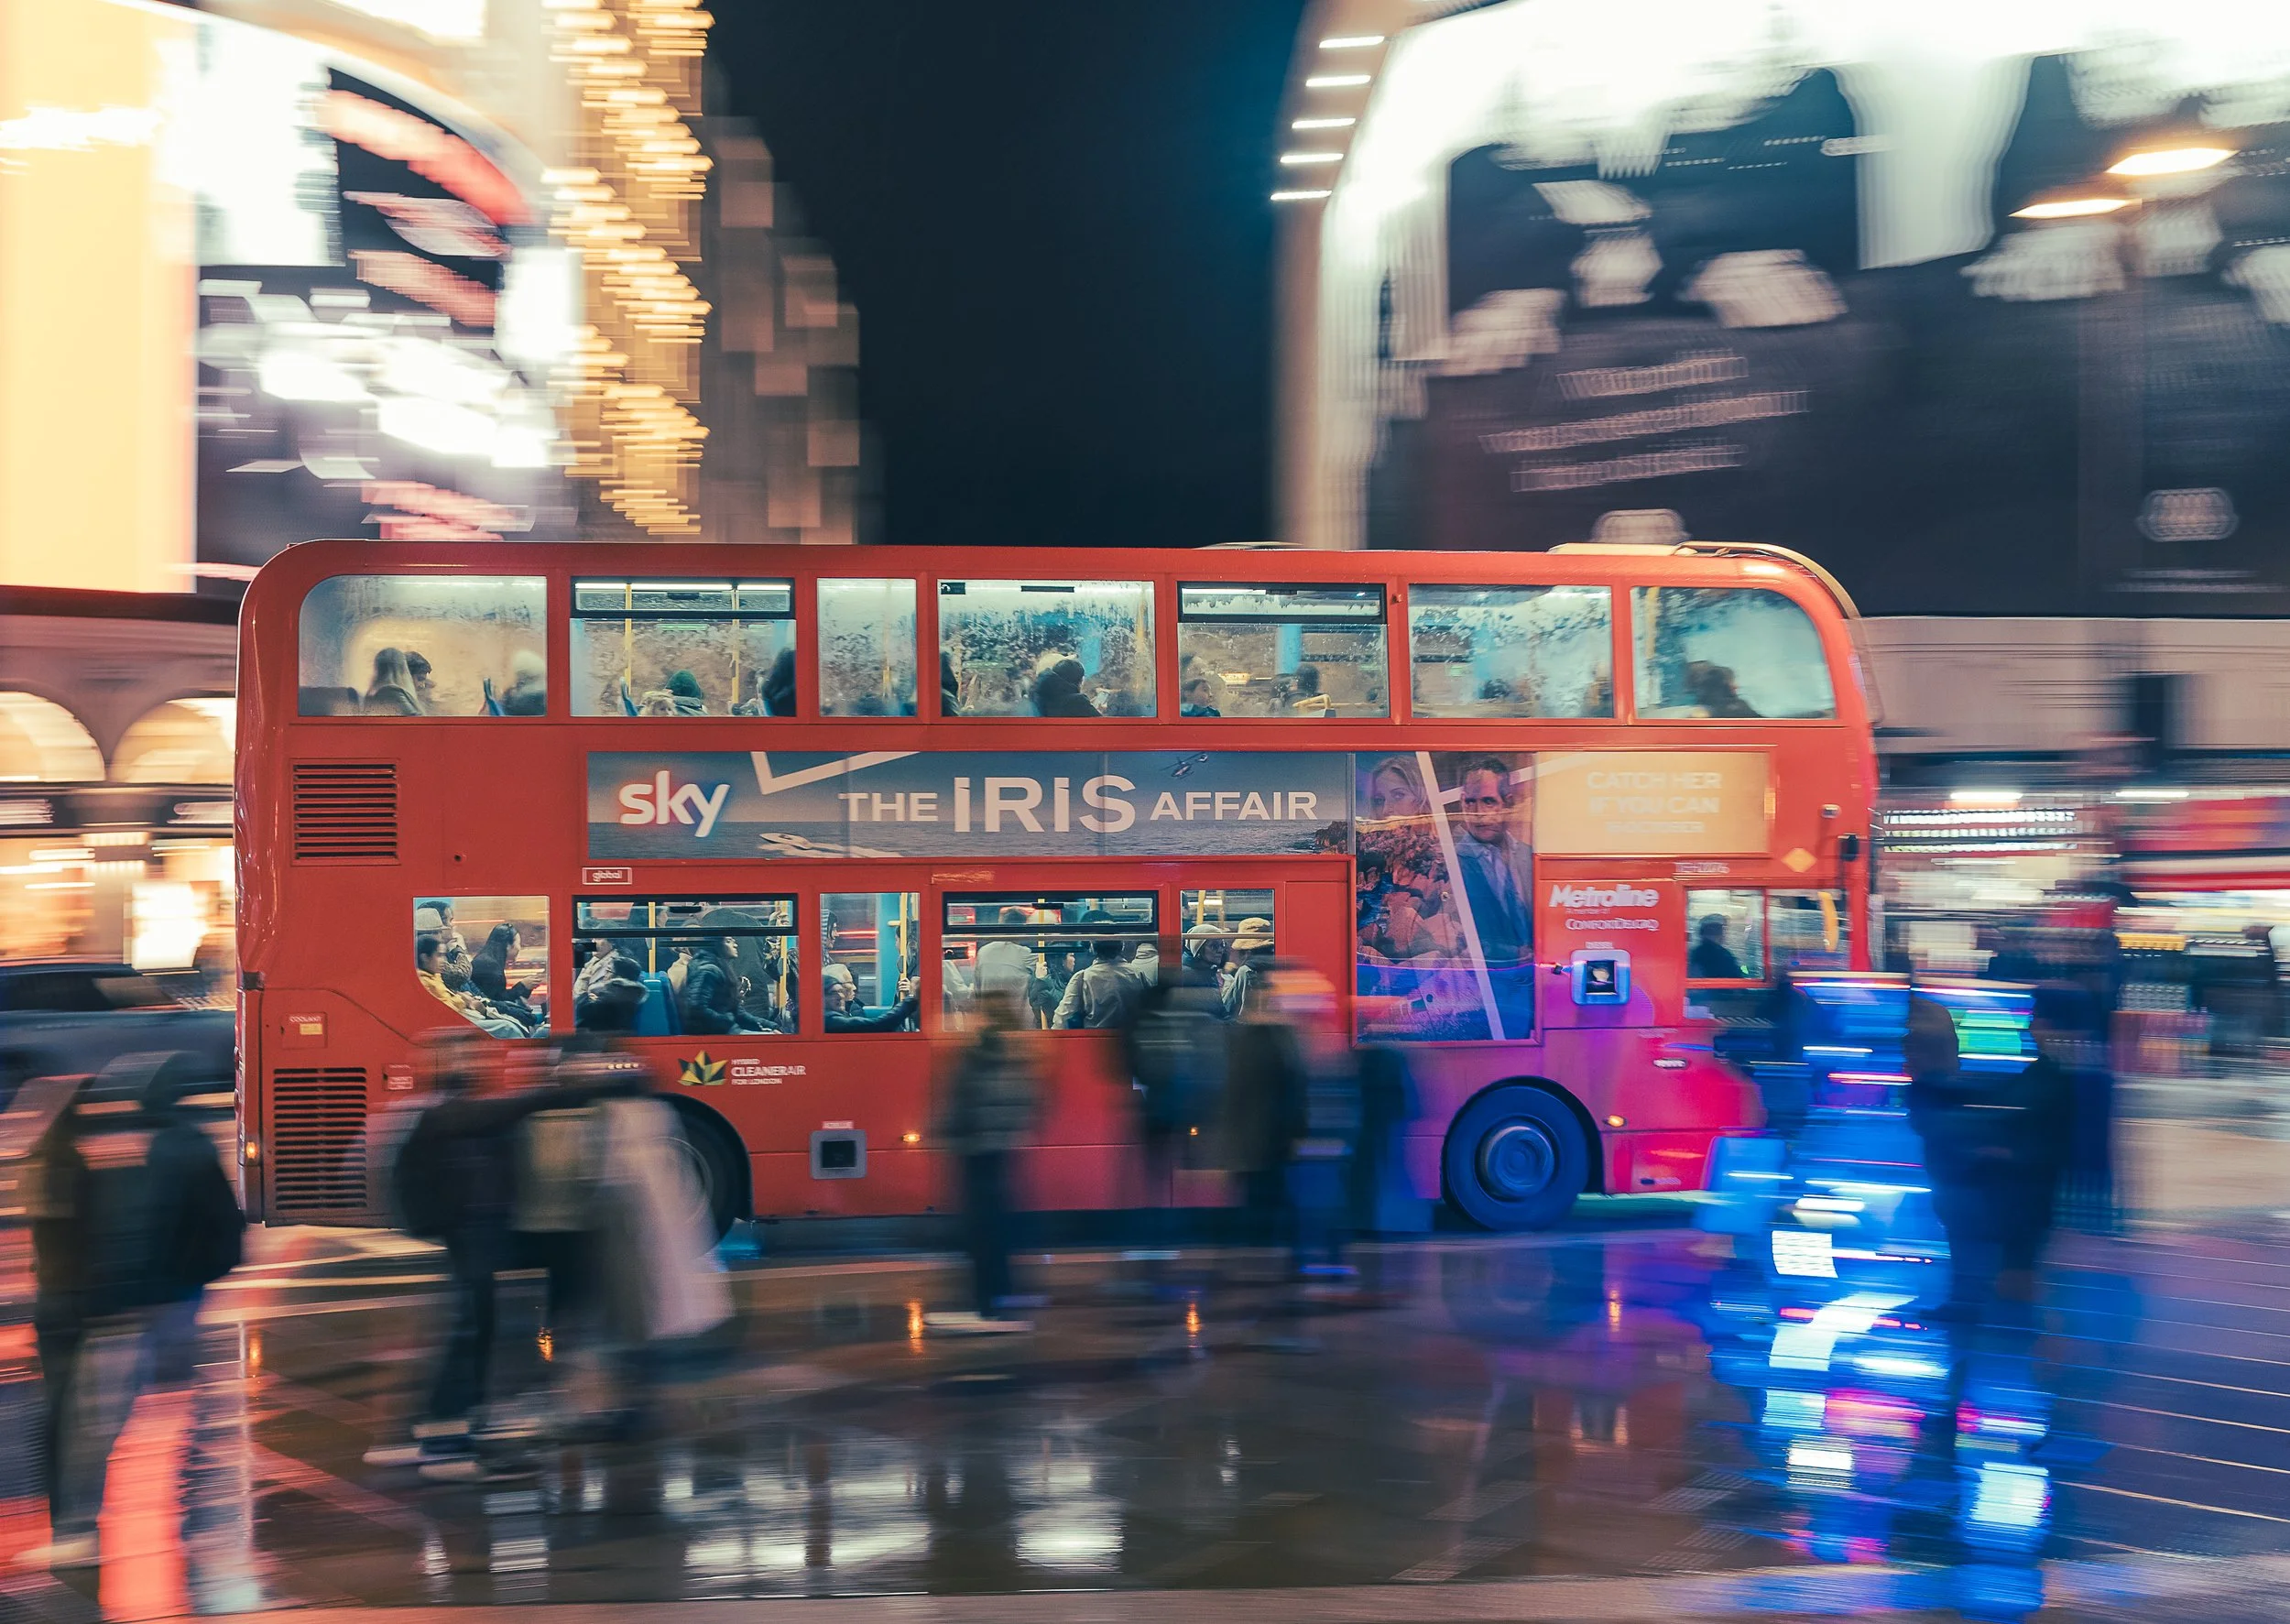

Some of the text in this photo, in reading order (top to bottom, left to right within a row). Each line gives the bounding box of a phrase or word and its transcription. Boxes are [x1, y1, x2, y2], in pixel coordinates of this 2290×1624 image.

[1587, 771, 1723, 790] CATCH HER
[617, 769, 730, 838] sky
[838, 791, 939, 822] THE
[1150, 790, 1319, 821] AFFAIR
[1589, 796, 1719, 813] IF YOU CAN
[593, 870, 623, 882] global
[1549, 884, 1660, 908] Metroline
